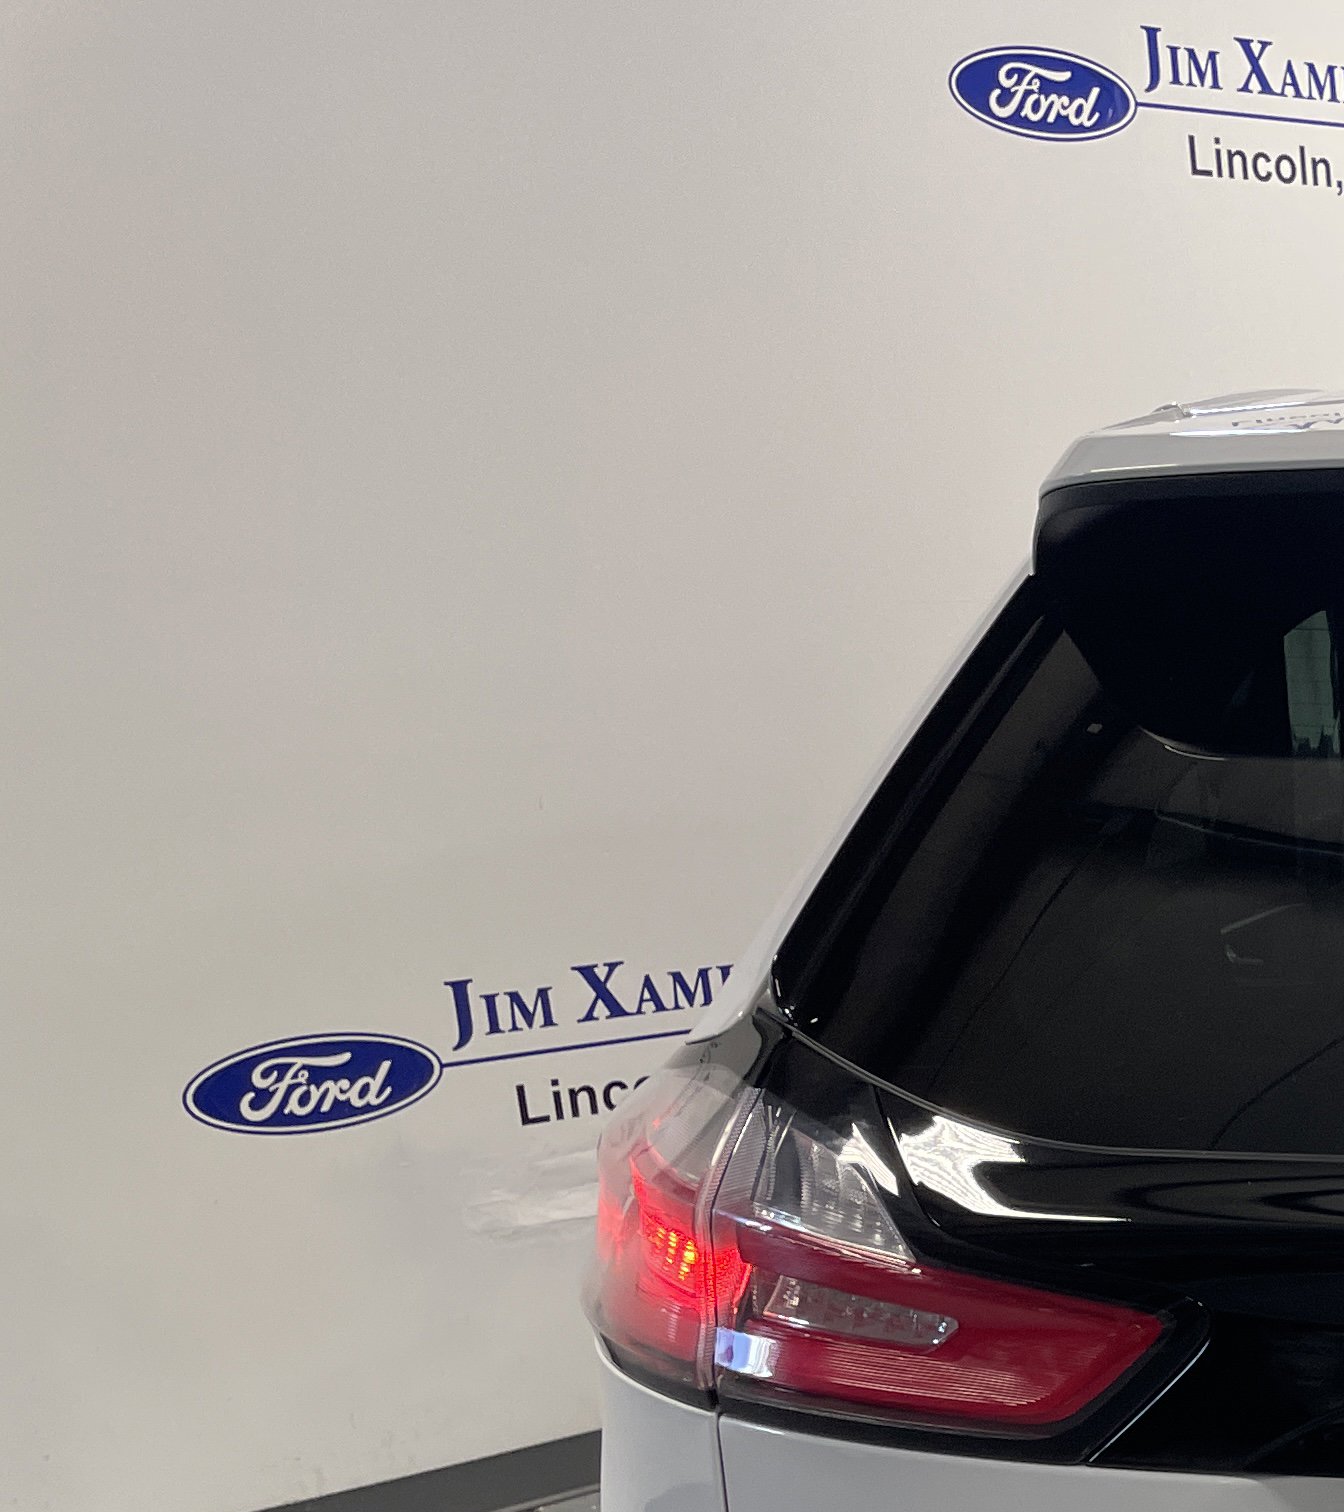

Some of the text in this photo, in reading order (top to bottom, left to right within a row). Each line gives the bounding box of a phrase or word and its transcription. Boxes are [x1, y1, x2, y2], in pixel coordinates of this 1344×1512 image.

[1140, 25, 1222, 93] JIM
[1188, 135, 1343, 196] Lincoln,
[443, 979, 557, 1051] JIM
[515, 1076, 650, 1126] Linc
